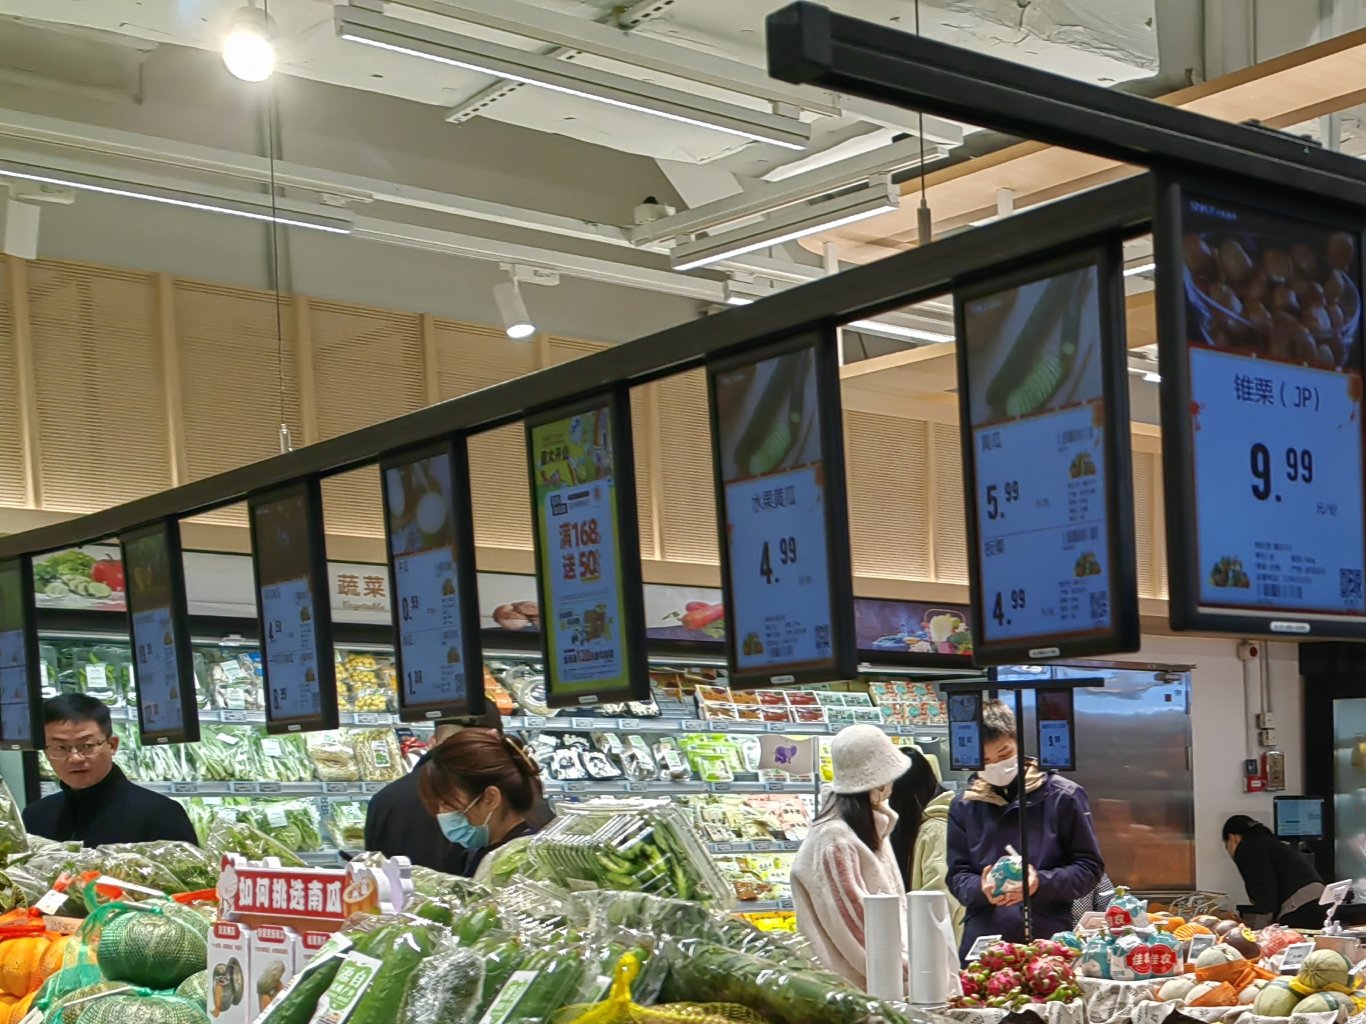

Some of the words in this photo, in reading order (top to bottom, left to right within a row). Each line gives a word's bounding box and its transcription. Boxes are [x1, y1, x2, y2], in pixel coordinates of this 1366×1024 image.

[1250, 442, 1314, 503] 9.99
[986, 480, 1020, 520] 5.99
[759, 536, 798, 585] 4.99
[337, 574, 386, 598] 蔬菜
[992, 589, 1026, 636] 4.99
[238, 876, 343, 914] 如何挑选南瓜
